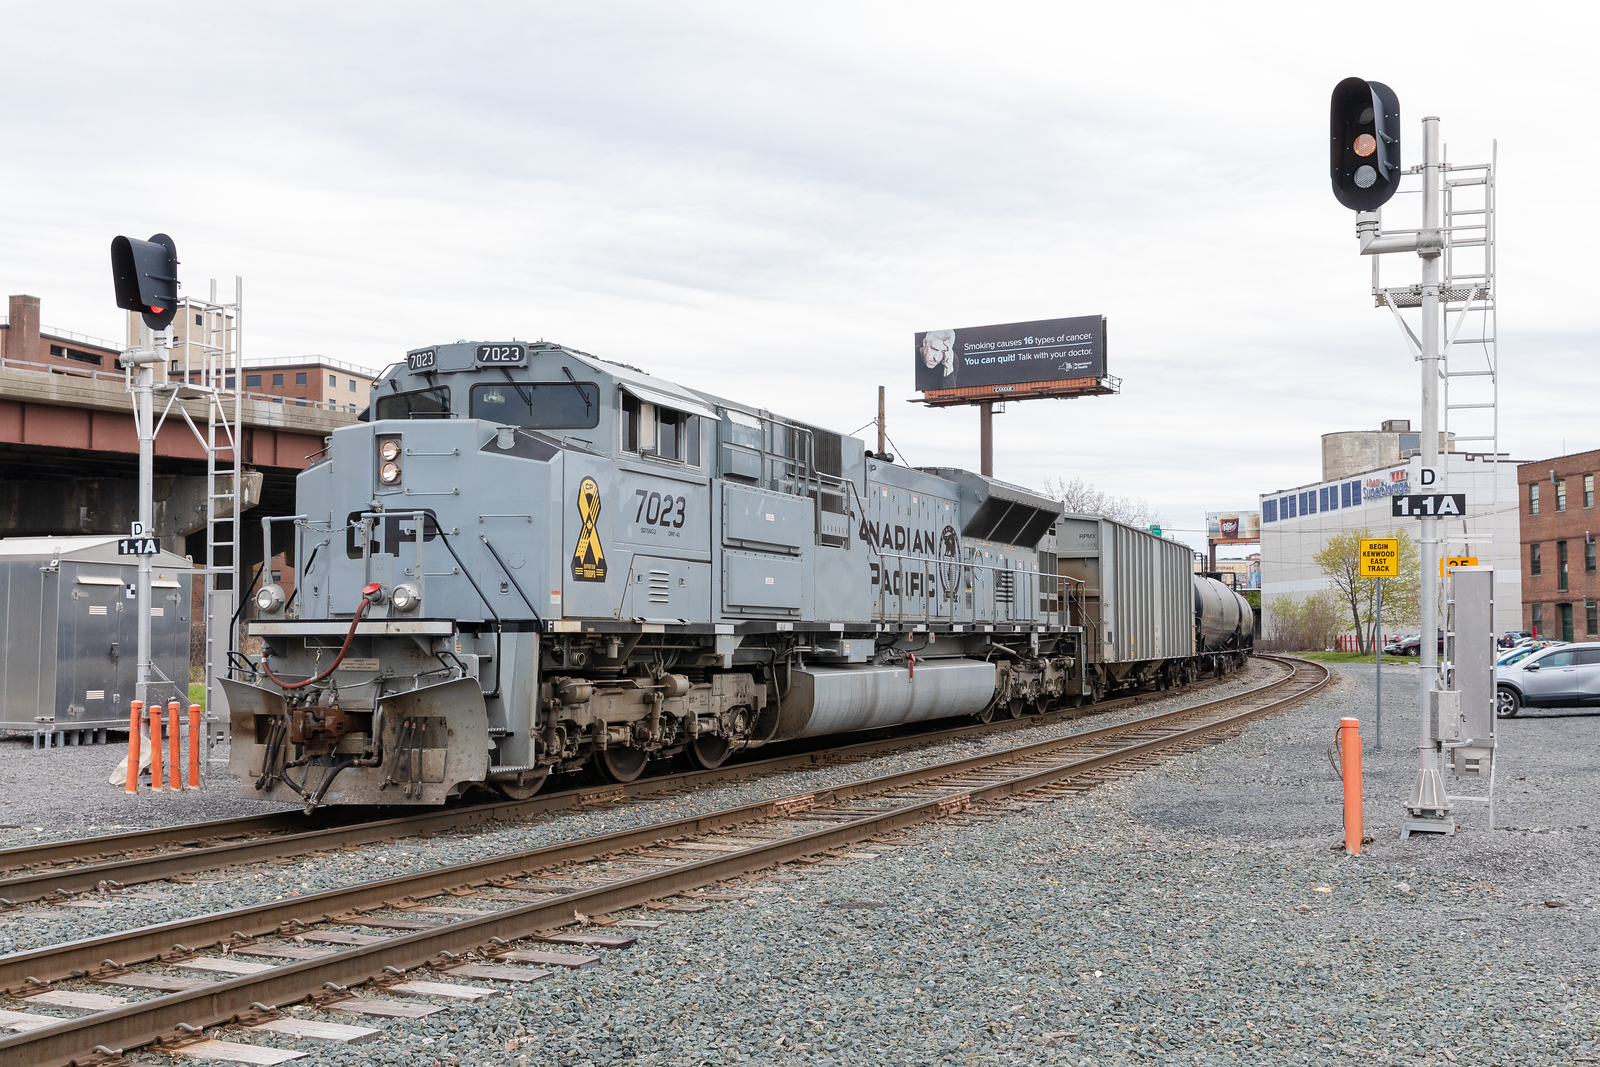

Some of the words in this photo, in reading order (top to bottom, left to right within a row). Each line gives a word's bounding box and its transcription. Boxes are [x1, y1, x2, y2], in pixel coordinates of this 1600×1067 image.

[964, 341, 996, 350] Smoking
[996, 339, 1022, 347] causes
[1024, 336, 1033, 345] 16
[1035, 336, 1055, 344] types
[1056, 334, 1065, 342] of
[1066, 333, 1092, 342] cancer.
[410, 352, 434, 369] 7023
[482, 347, 520, 361] 7023
[964, 358, 979, 366] You
[997, 354, 1015, 364] quit!
[1018, 352, 1032, 361] Talk
[1050, 350, 1066, 360] your
[1421, 469, 1435, 485] D
[1363, 482, 1408, 501] SuperStorage
[635, 489, 686, 528] 7023
[1397, 496, 1459, 515] 1.1A
[134, 523, 142, 535] D
[850, 510, 935, 555] ANADIAN
[121, 540, 157, 554] 1.1A
[869, 563, 935, 597] PACIFIC
[548, 621, 553, 632] F
